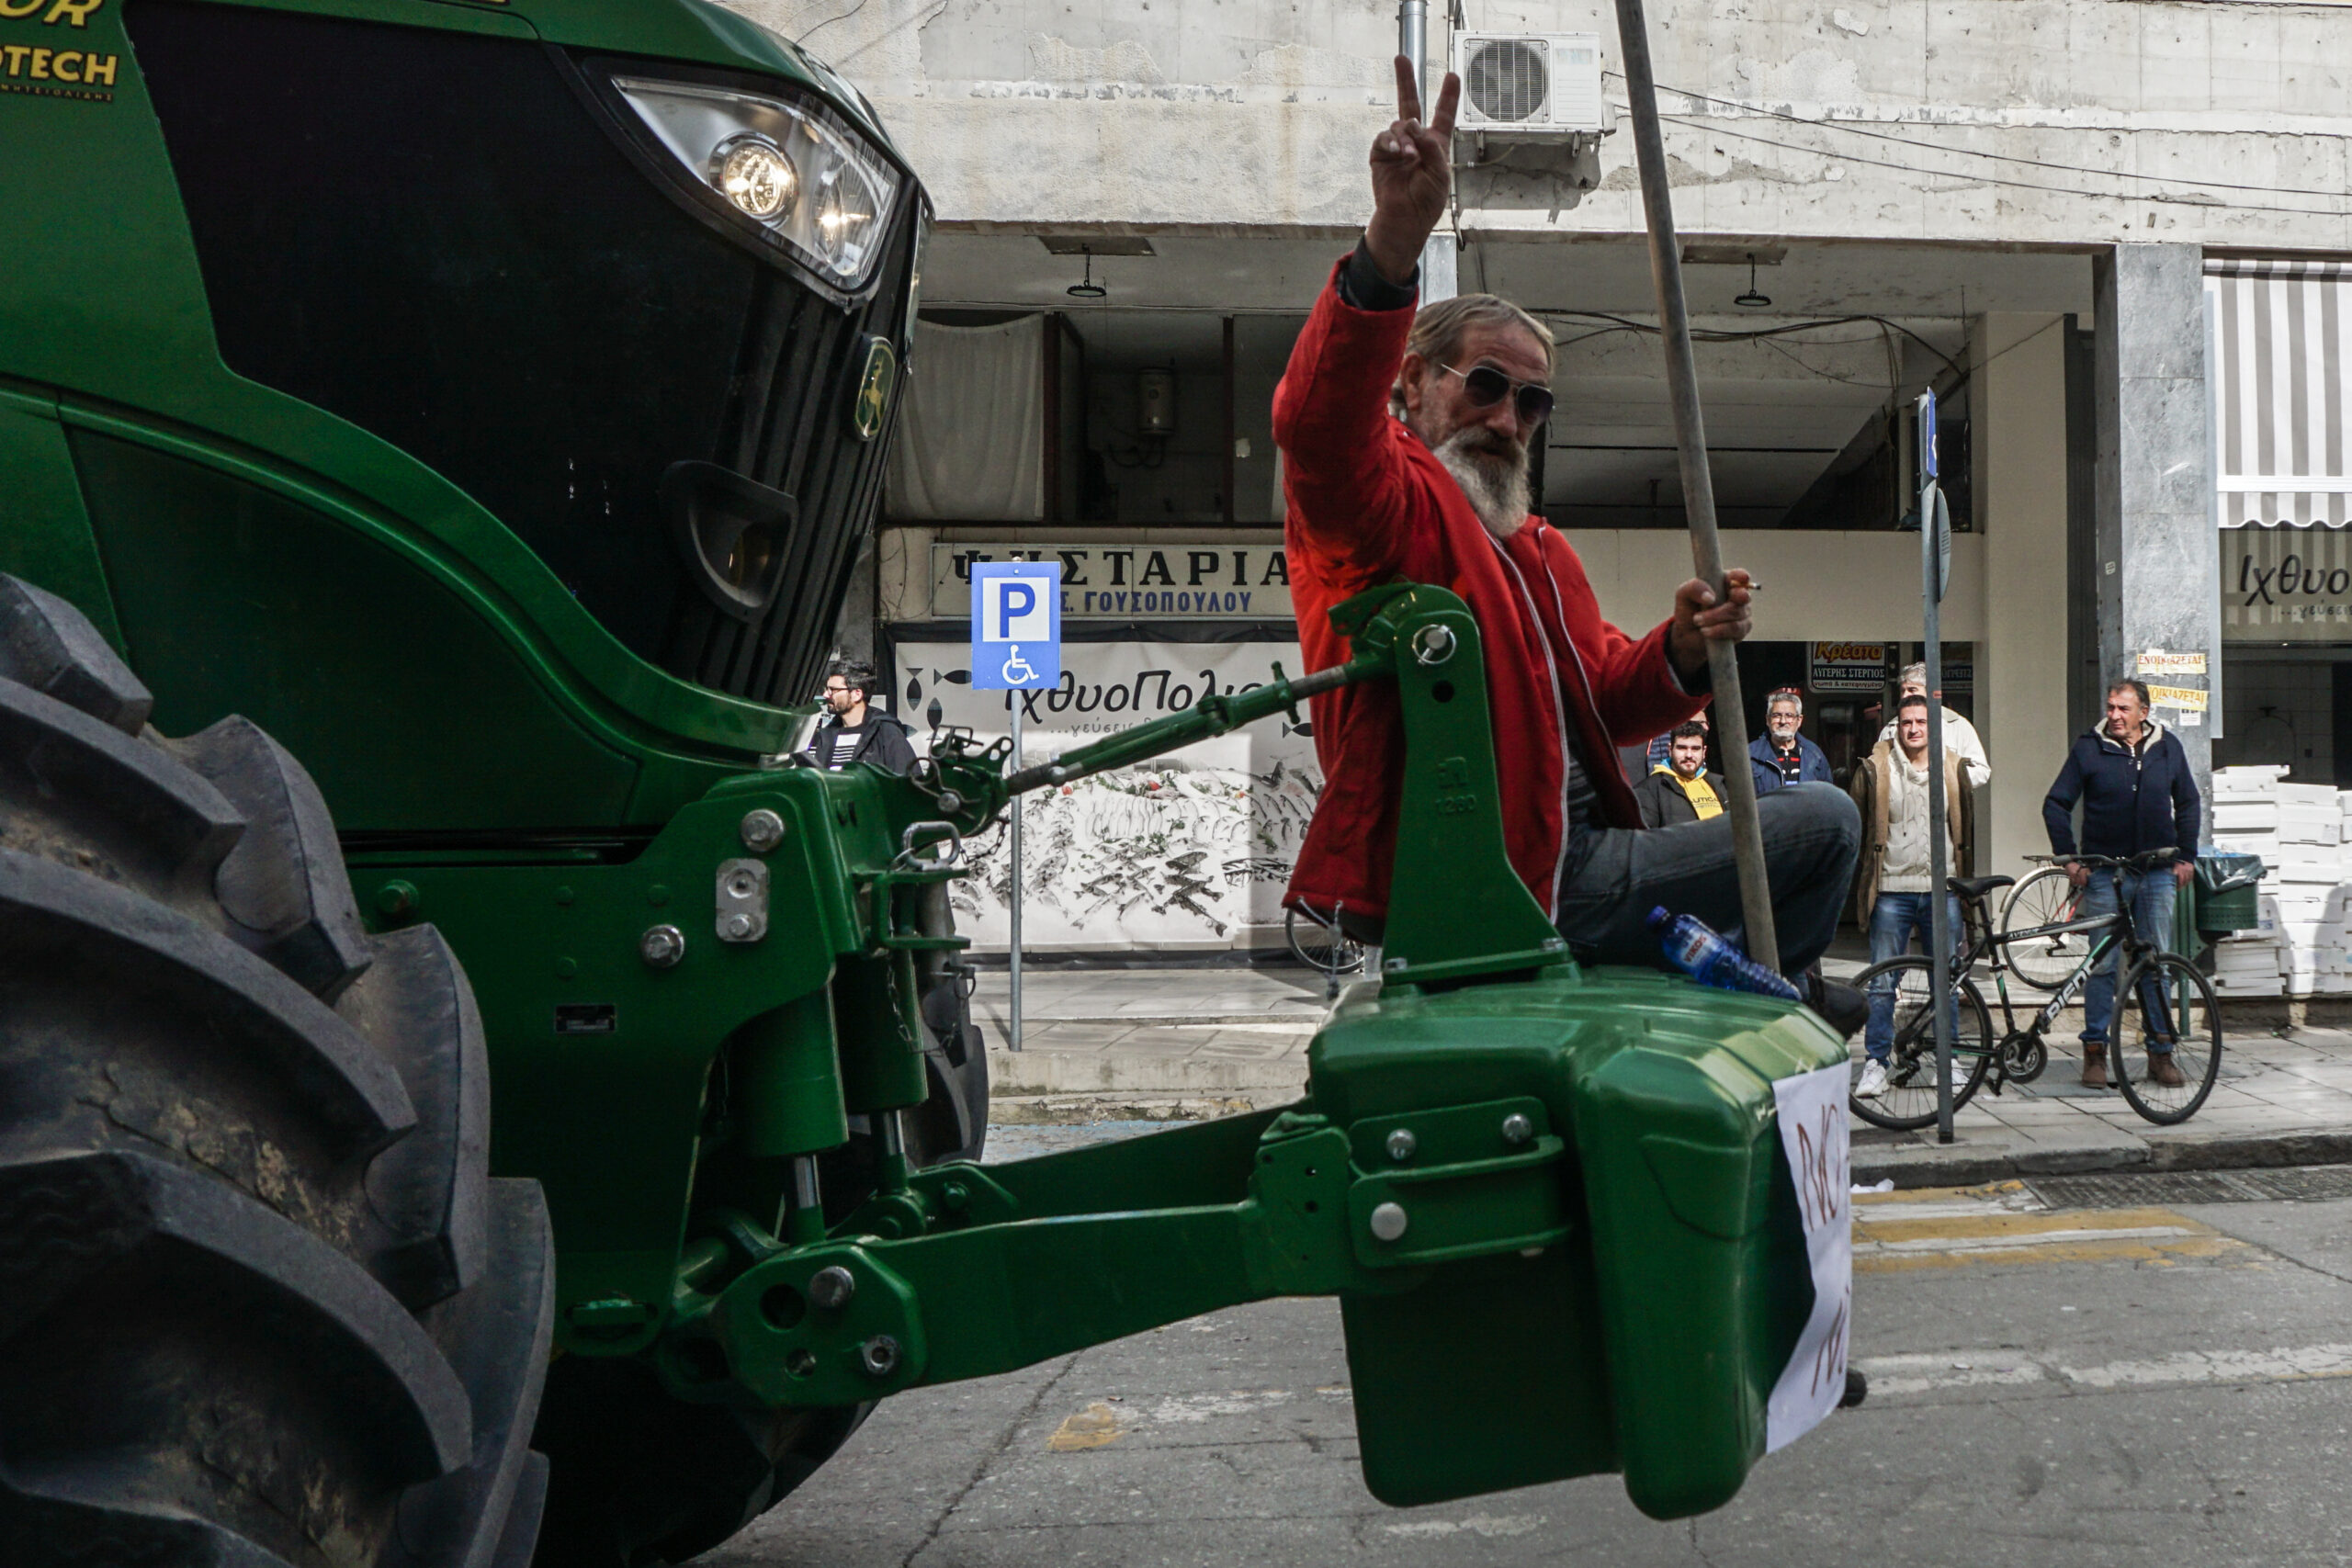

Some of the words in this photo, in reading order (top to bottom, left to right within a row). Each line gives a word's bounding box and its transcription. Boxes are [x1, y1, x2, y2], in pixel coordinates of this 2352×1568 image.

[0, 45, 118, 86] TECH
[1000, 582, 1036, 638] P
[1085, 591, 1251, 613] ΓΟΥΣΟΠΟΥΛΟΥ
[1813, 668, 1847, 678] ΑΥΓΕΡΗΣ
[1849, 668, 1885, 678] ΣΤΕΡΓΙΟΣ
